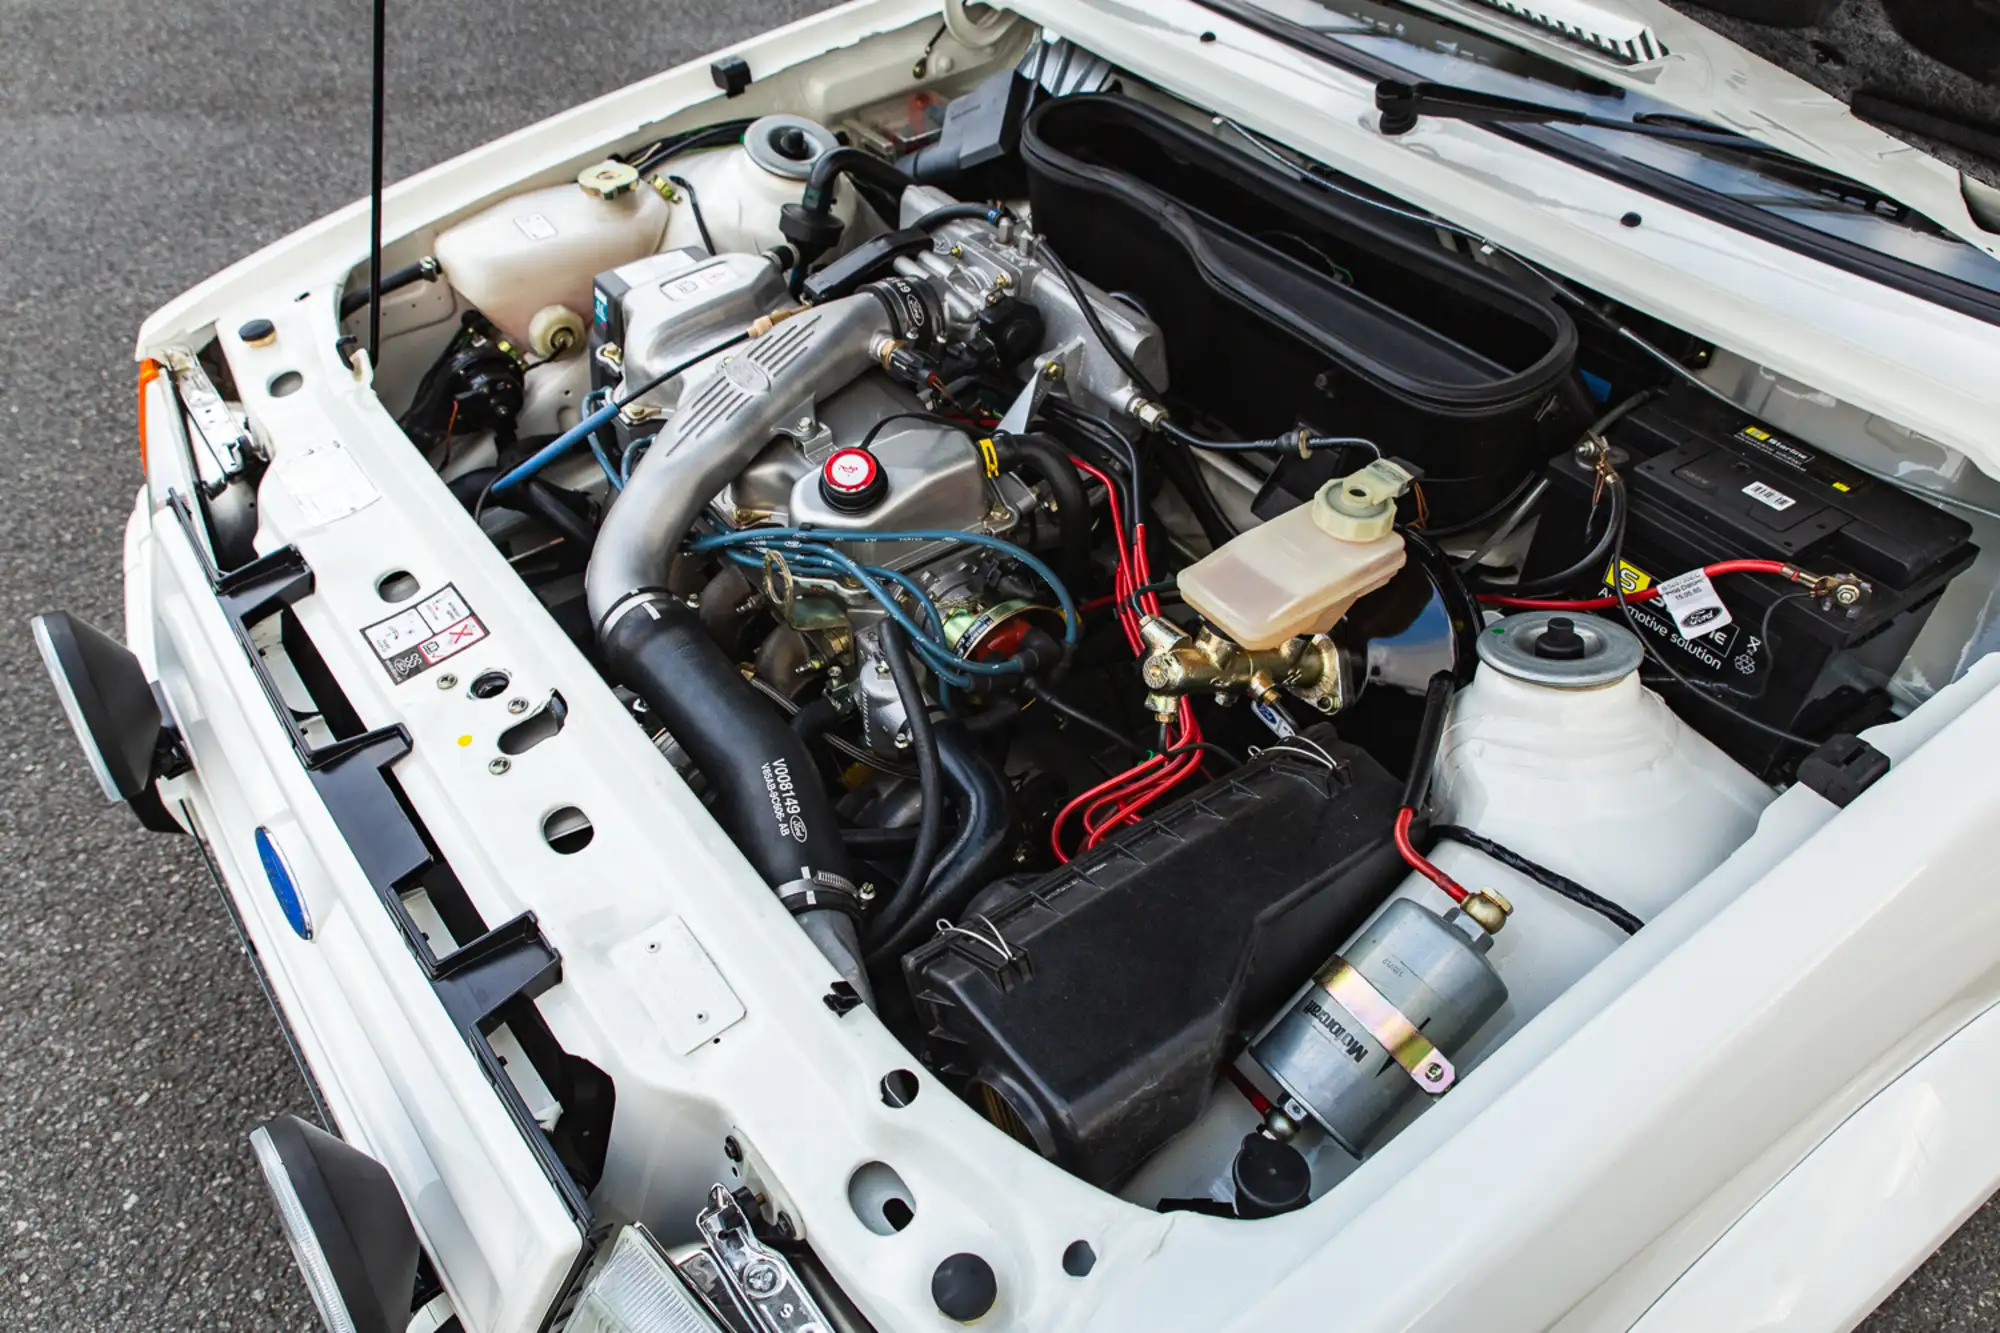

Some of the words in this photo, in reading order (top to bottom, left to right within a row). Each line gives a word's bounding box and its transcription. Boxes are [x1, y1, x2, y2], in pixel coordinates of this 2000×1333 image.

[1620, 568, 1639, 591] S
[1598, 587, 1668, 637] Amotive
[1671, 633, 1722, 669] solution
[1689, 609, 1714, 625] Ford
[772, 758, 801, 814] V008149
[778, 823, 790, 837] AB
[1303, 999, 1369, 1064] Motorcraft
